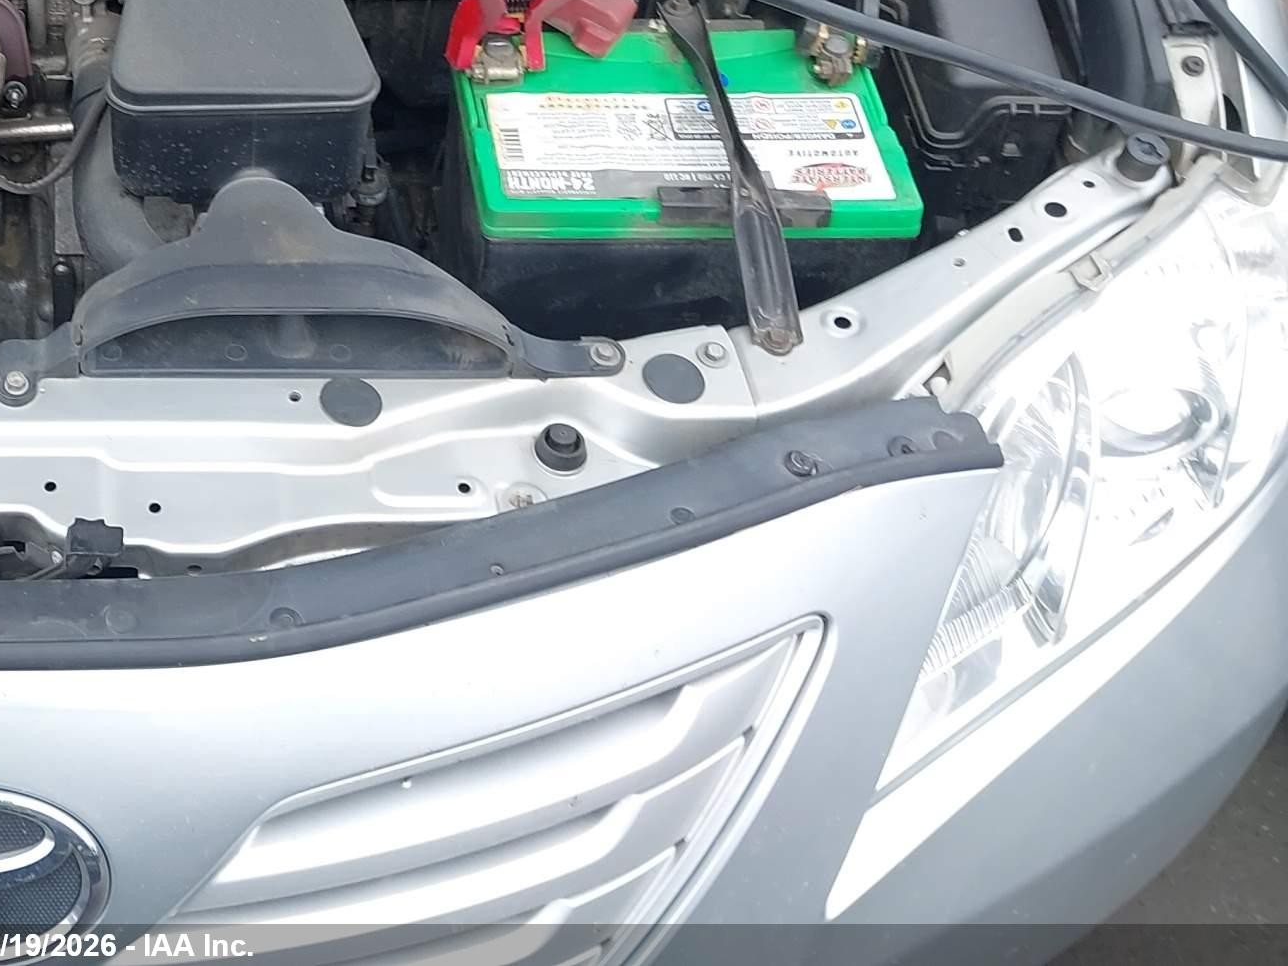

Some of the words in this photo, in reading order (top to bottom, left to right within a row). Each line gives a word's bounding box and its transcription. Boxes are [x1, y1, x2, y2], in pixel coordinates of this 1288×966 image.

[788, 149, 858, 157] AUTOMOTIVE
[507, 177, 595, 191] 24-MONTH
[791, 175, 872, 184] INTERSTATE
